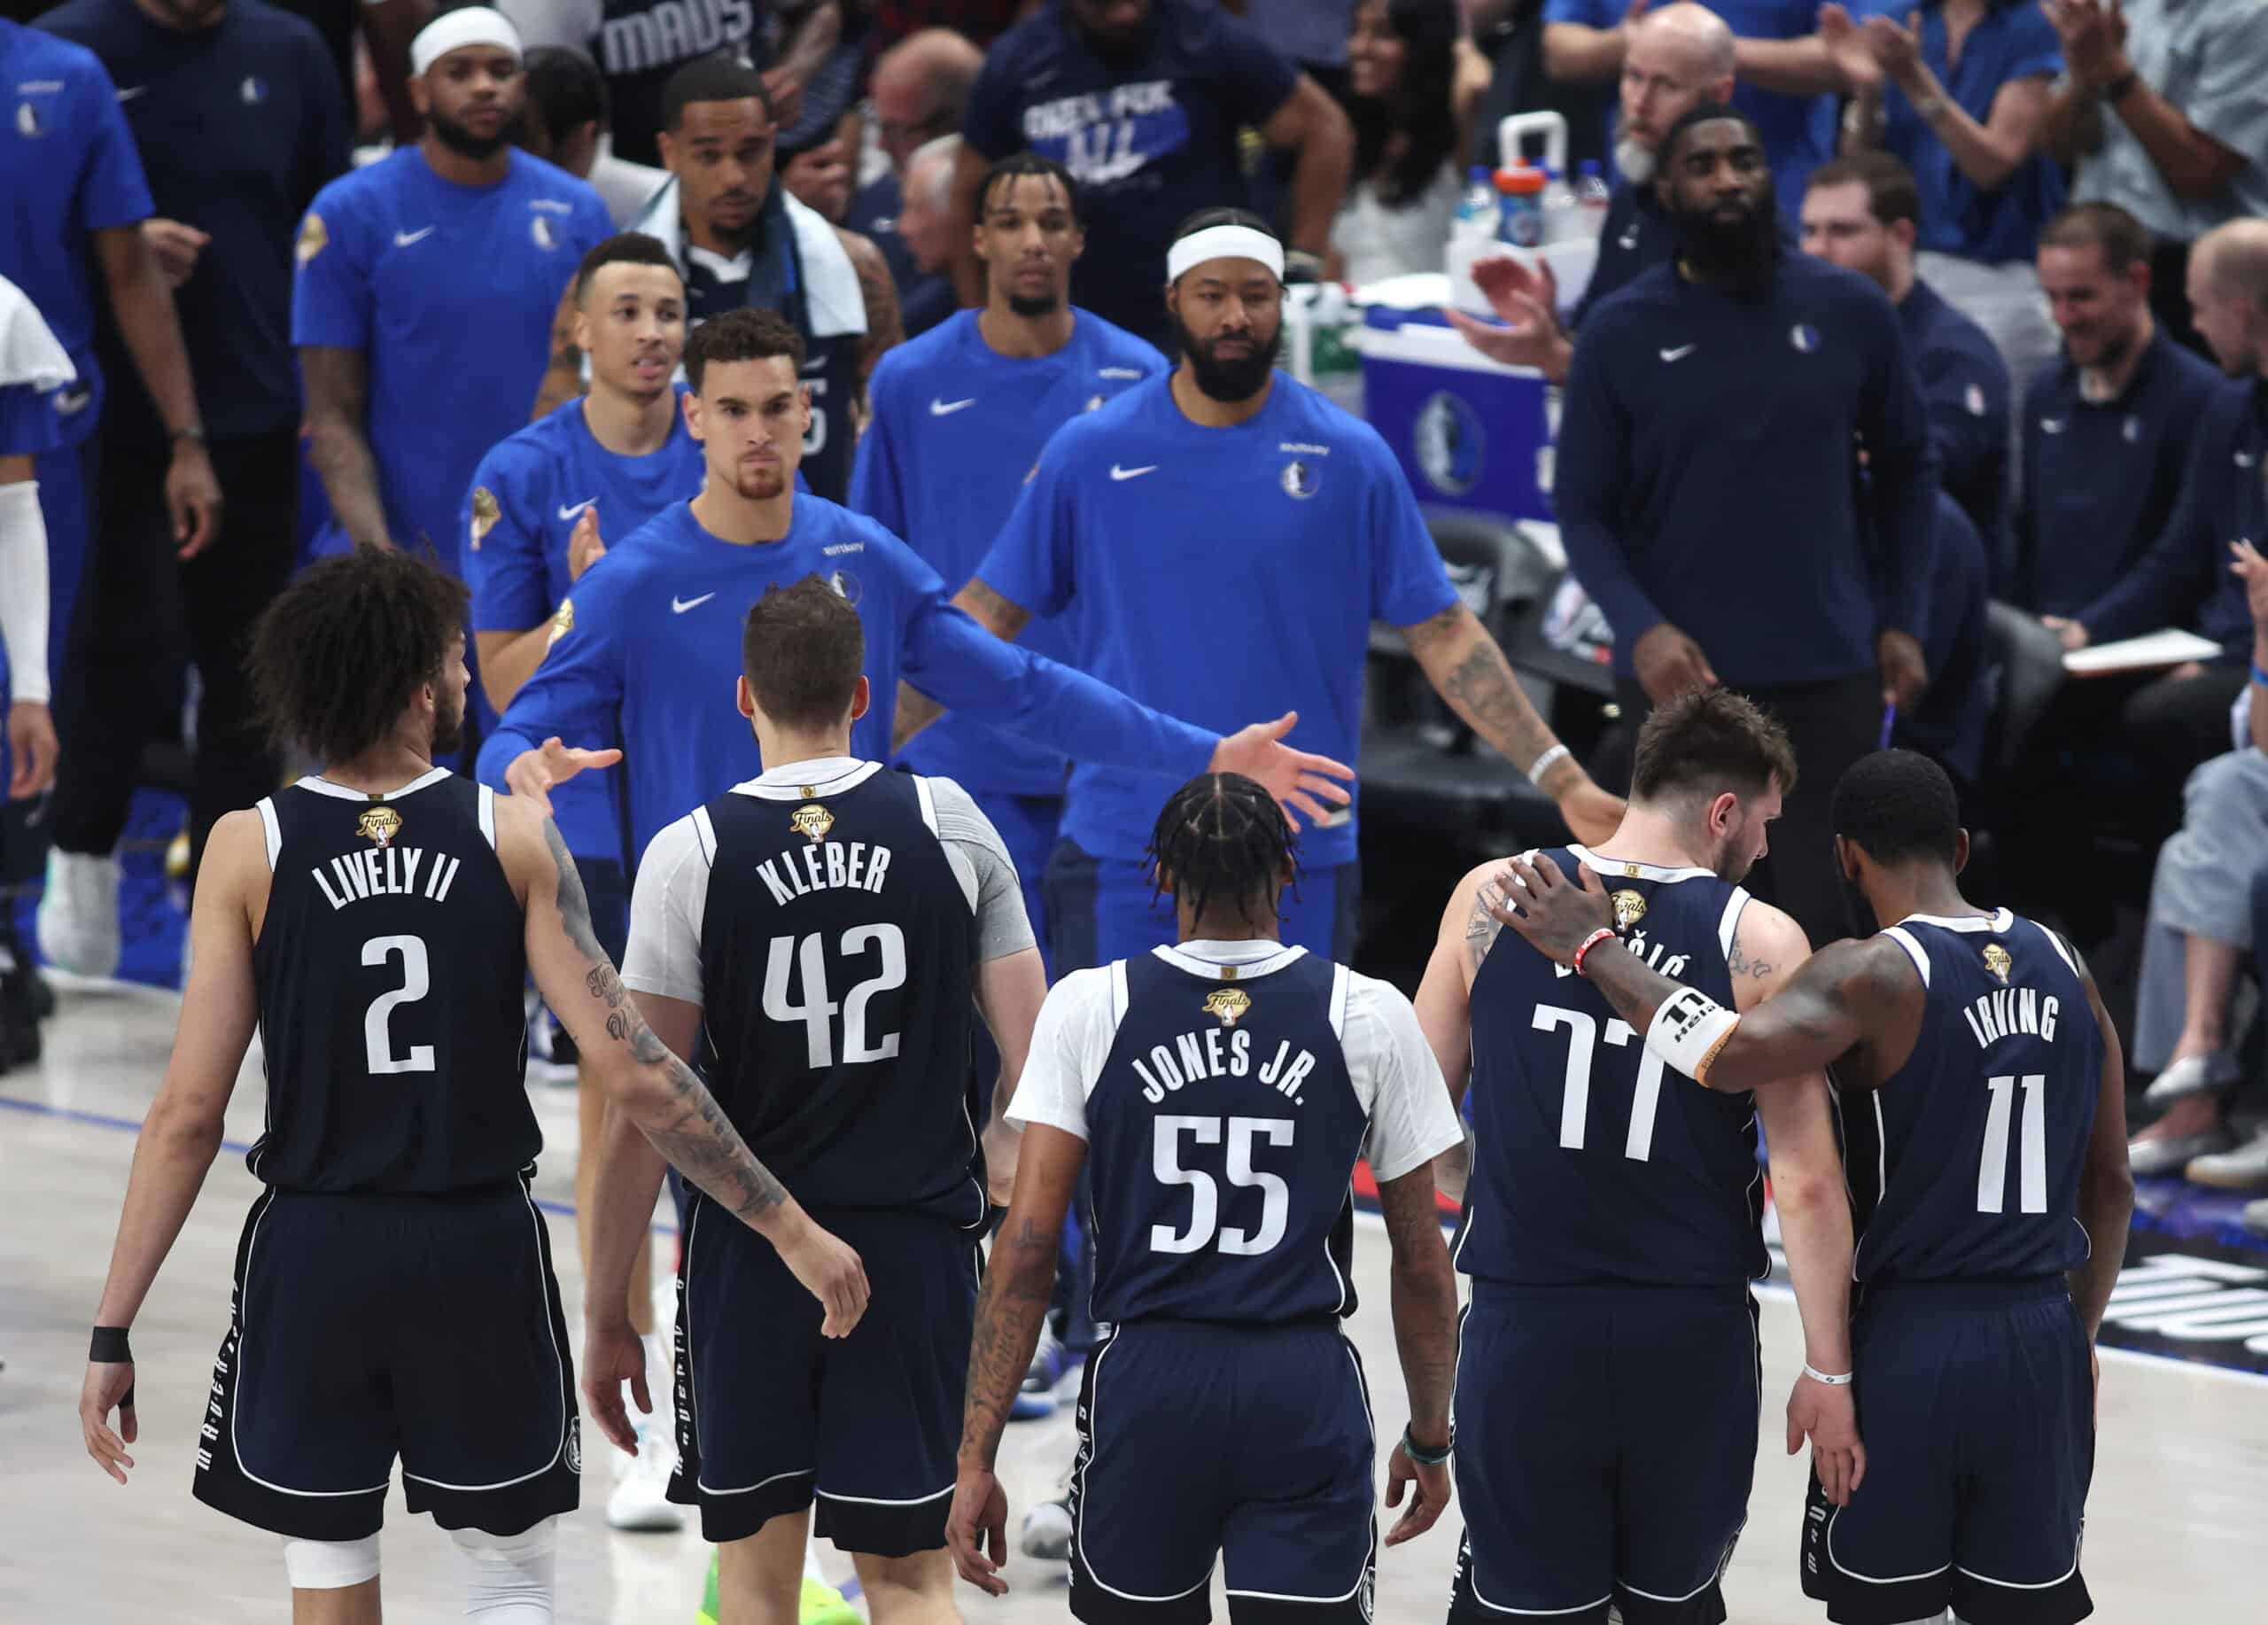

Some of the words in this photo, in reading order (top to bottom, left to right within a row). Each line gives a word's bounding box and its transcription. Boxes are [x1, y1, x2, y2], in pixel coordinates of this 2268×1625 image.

[357, 812, 402, 833] Finals
[791, 807, 834, 831] Finals
[312, 847, 423, 911] LIVELY
[424, 852, 461, 902] II
[756, 842, 891, 906] KLEBER
[361, 935, 436, 1075] 2
[762, 922, 907, 1069] 42
[1204, 990, 1252, 1010] Finals
[1662, 992, 1706, 1025] 11
[1963, 987, 2059, 1049] IRVING
[1131, 1027, 1251, 1104] JONES
[1258, 1039, 1317, 1107] JR.
[1531, 1002, 1664, 1163] 77
[1977, 1074, 2047, 1214] 11
[1149, 1115, 1295, 1256] 55
